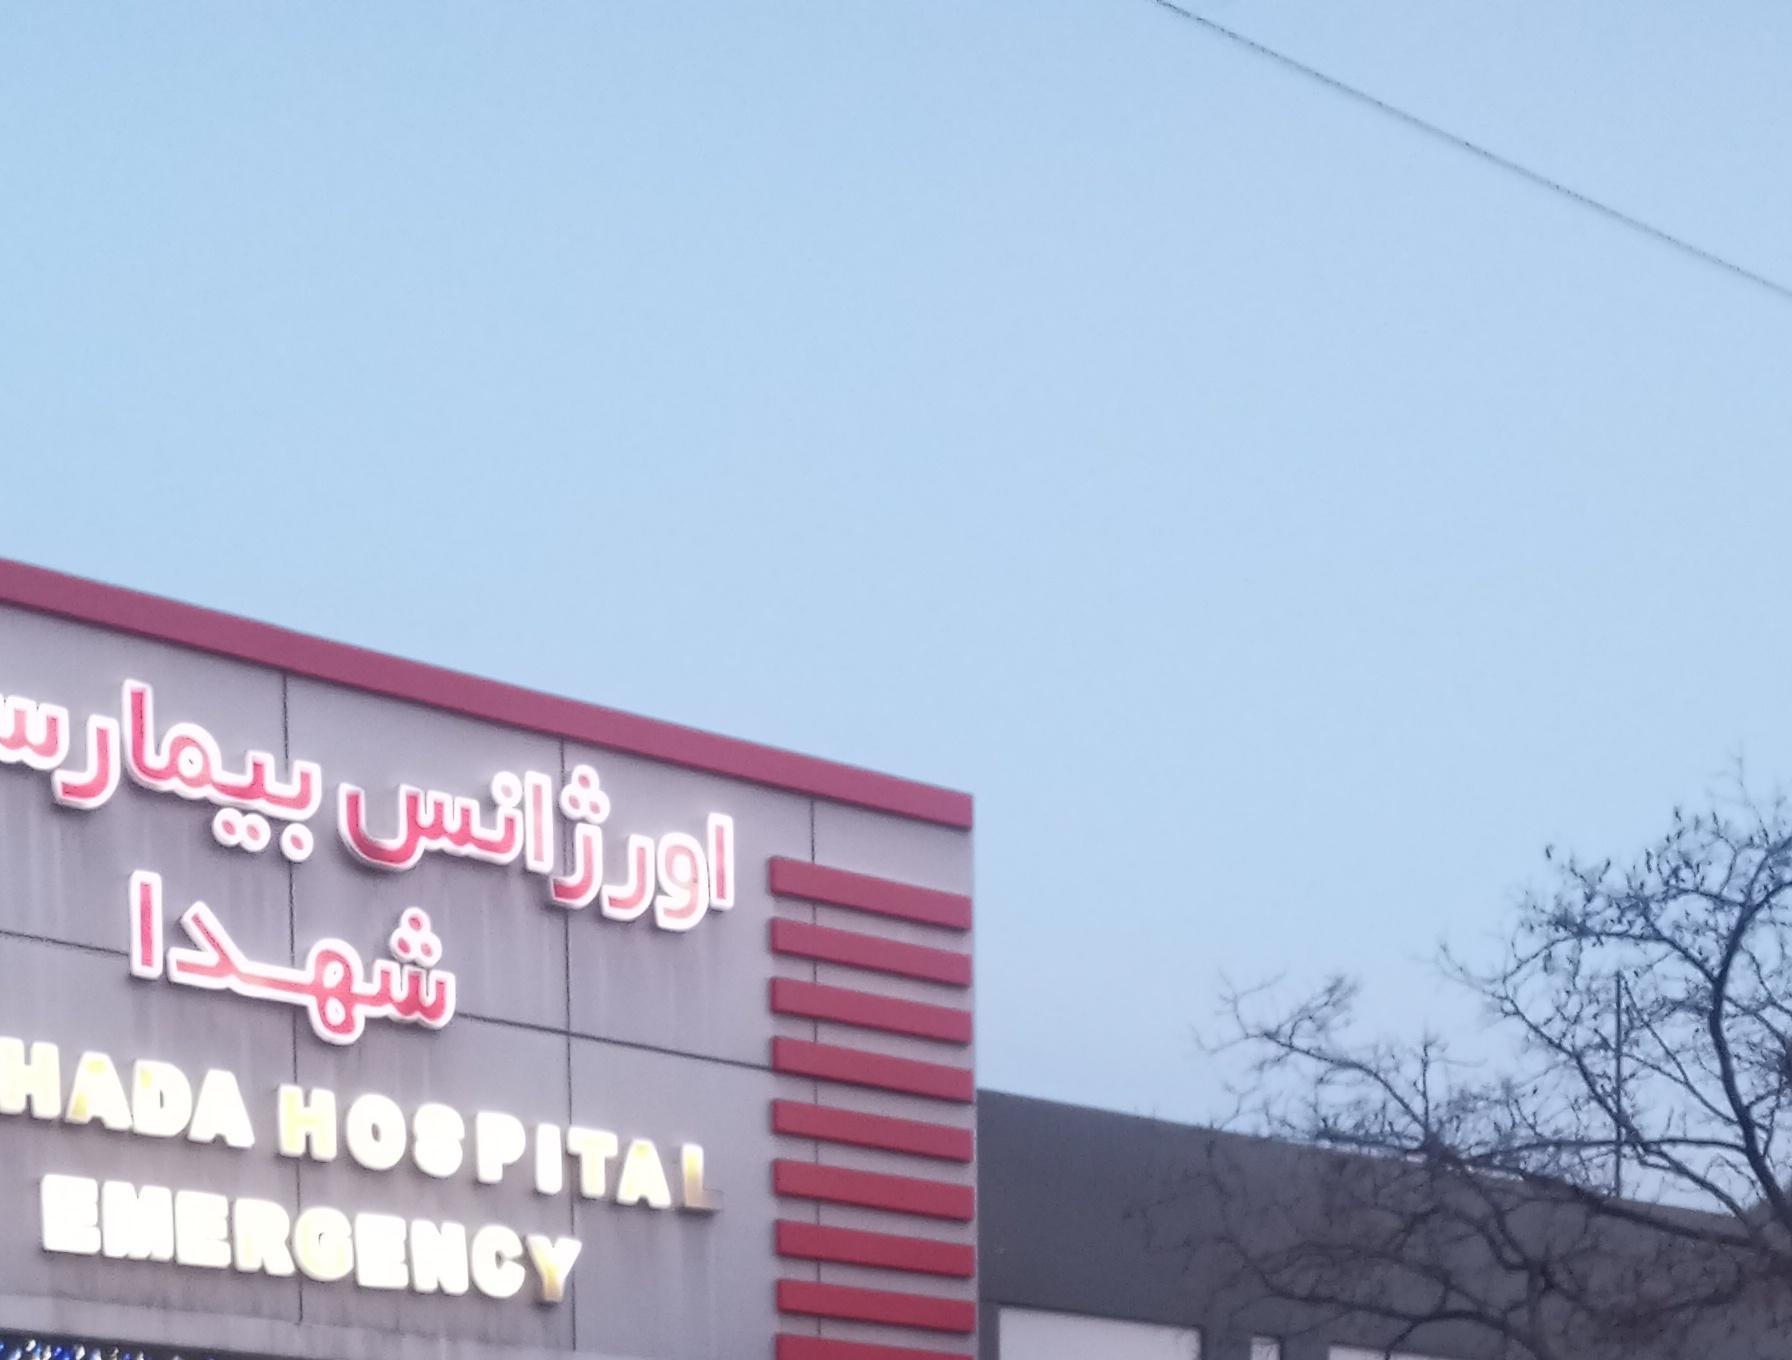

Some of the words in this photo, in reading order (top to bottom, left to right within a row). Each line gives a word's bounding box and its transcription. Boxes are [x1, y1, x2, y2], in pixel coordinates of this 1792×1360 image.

[338, 765, 734, 932] اورژانس
[129, 870, 456, 1045] شهدا
[277, 1083, 718, 1212] HOSPITAL
[41, 1173, 582, 1302] EMERGENCY
